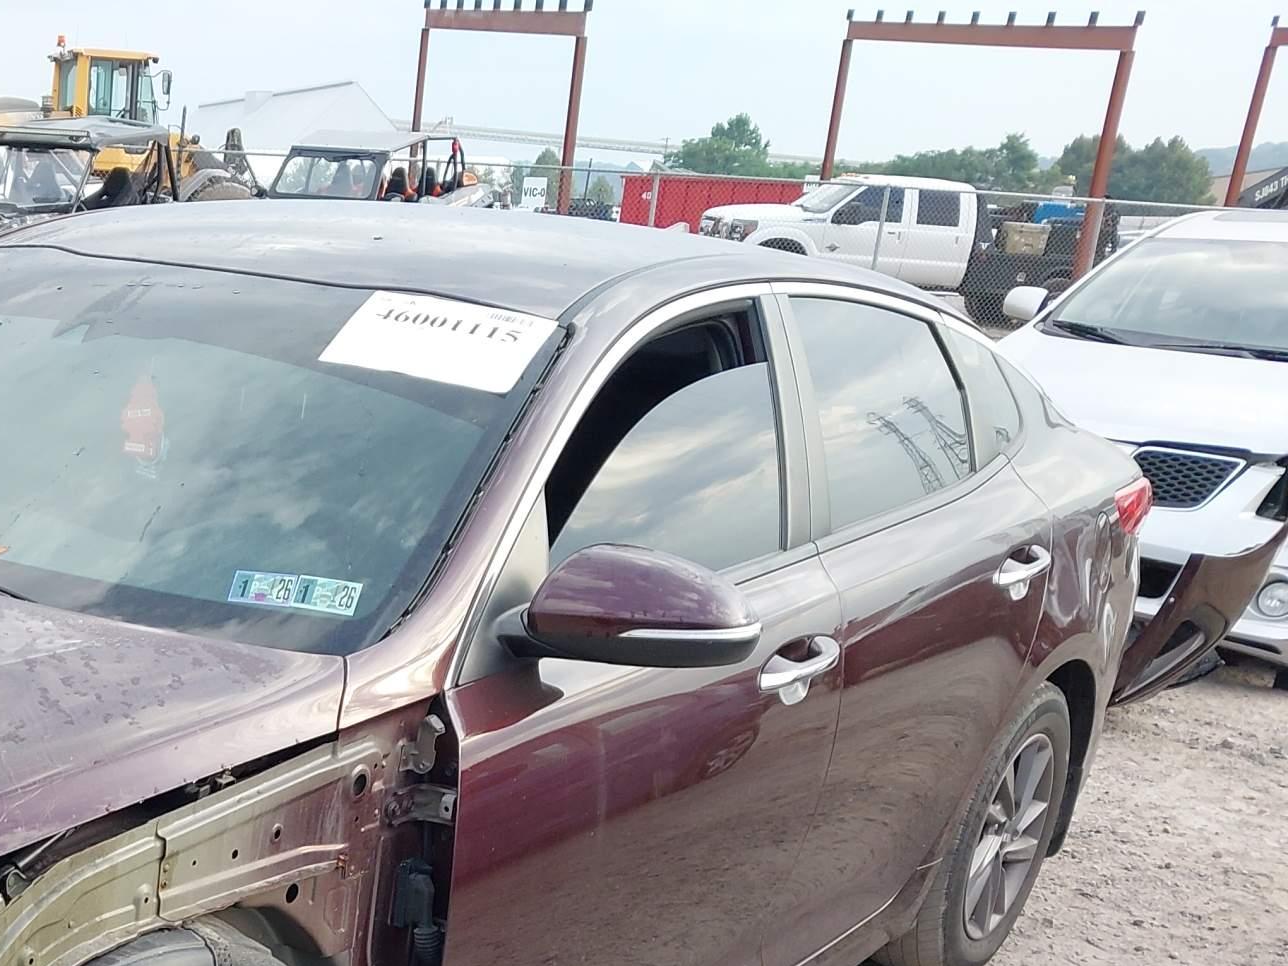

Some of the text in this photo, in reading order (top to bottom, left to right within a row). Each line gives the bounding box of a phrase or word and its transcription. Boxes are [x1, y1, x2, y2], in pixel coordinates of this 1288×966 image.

[376, 308, 523, 343] 46001115
[240, 578, 293, 600] 1 26
[301, 584, 357, 609] 1 26
